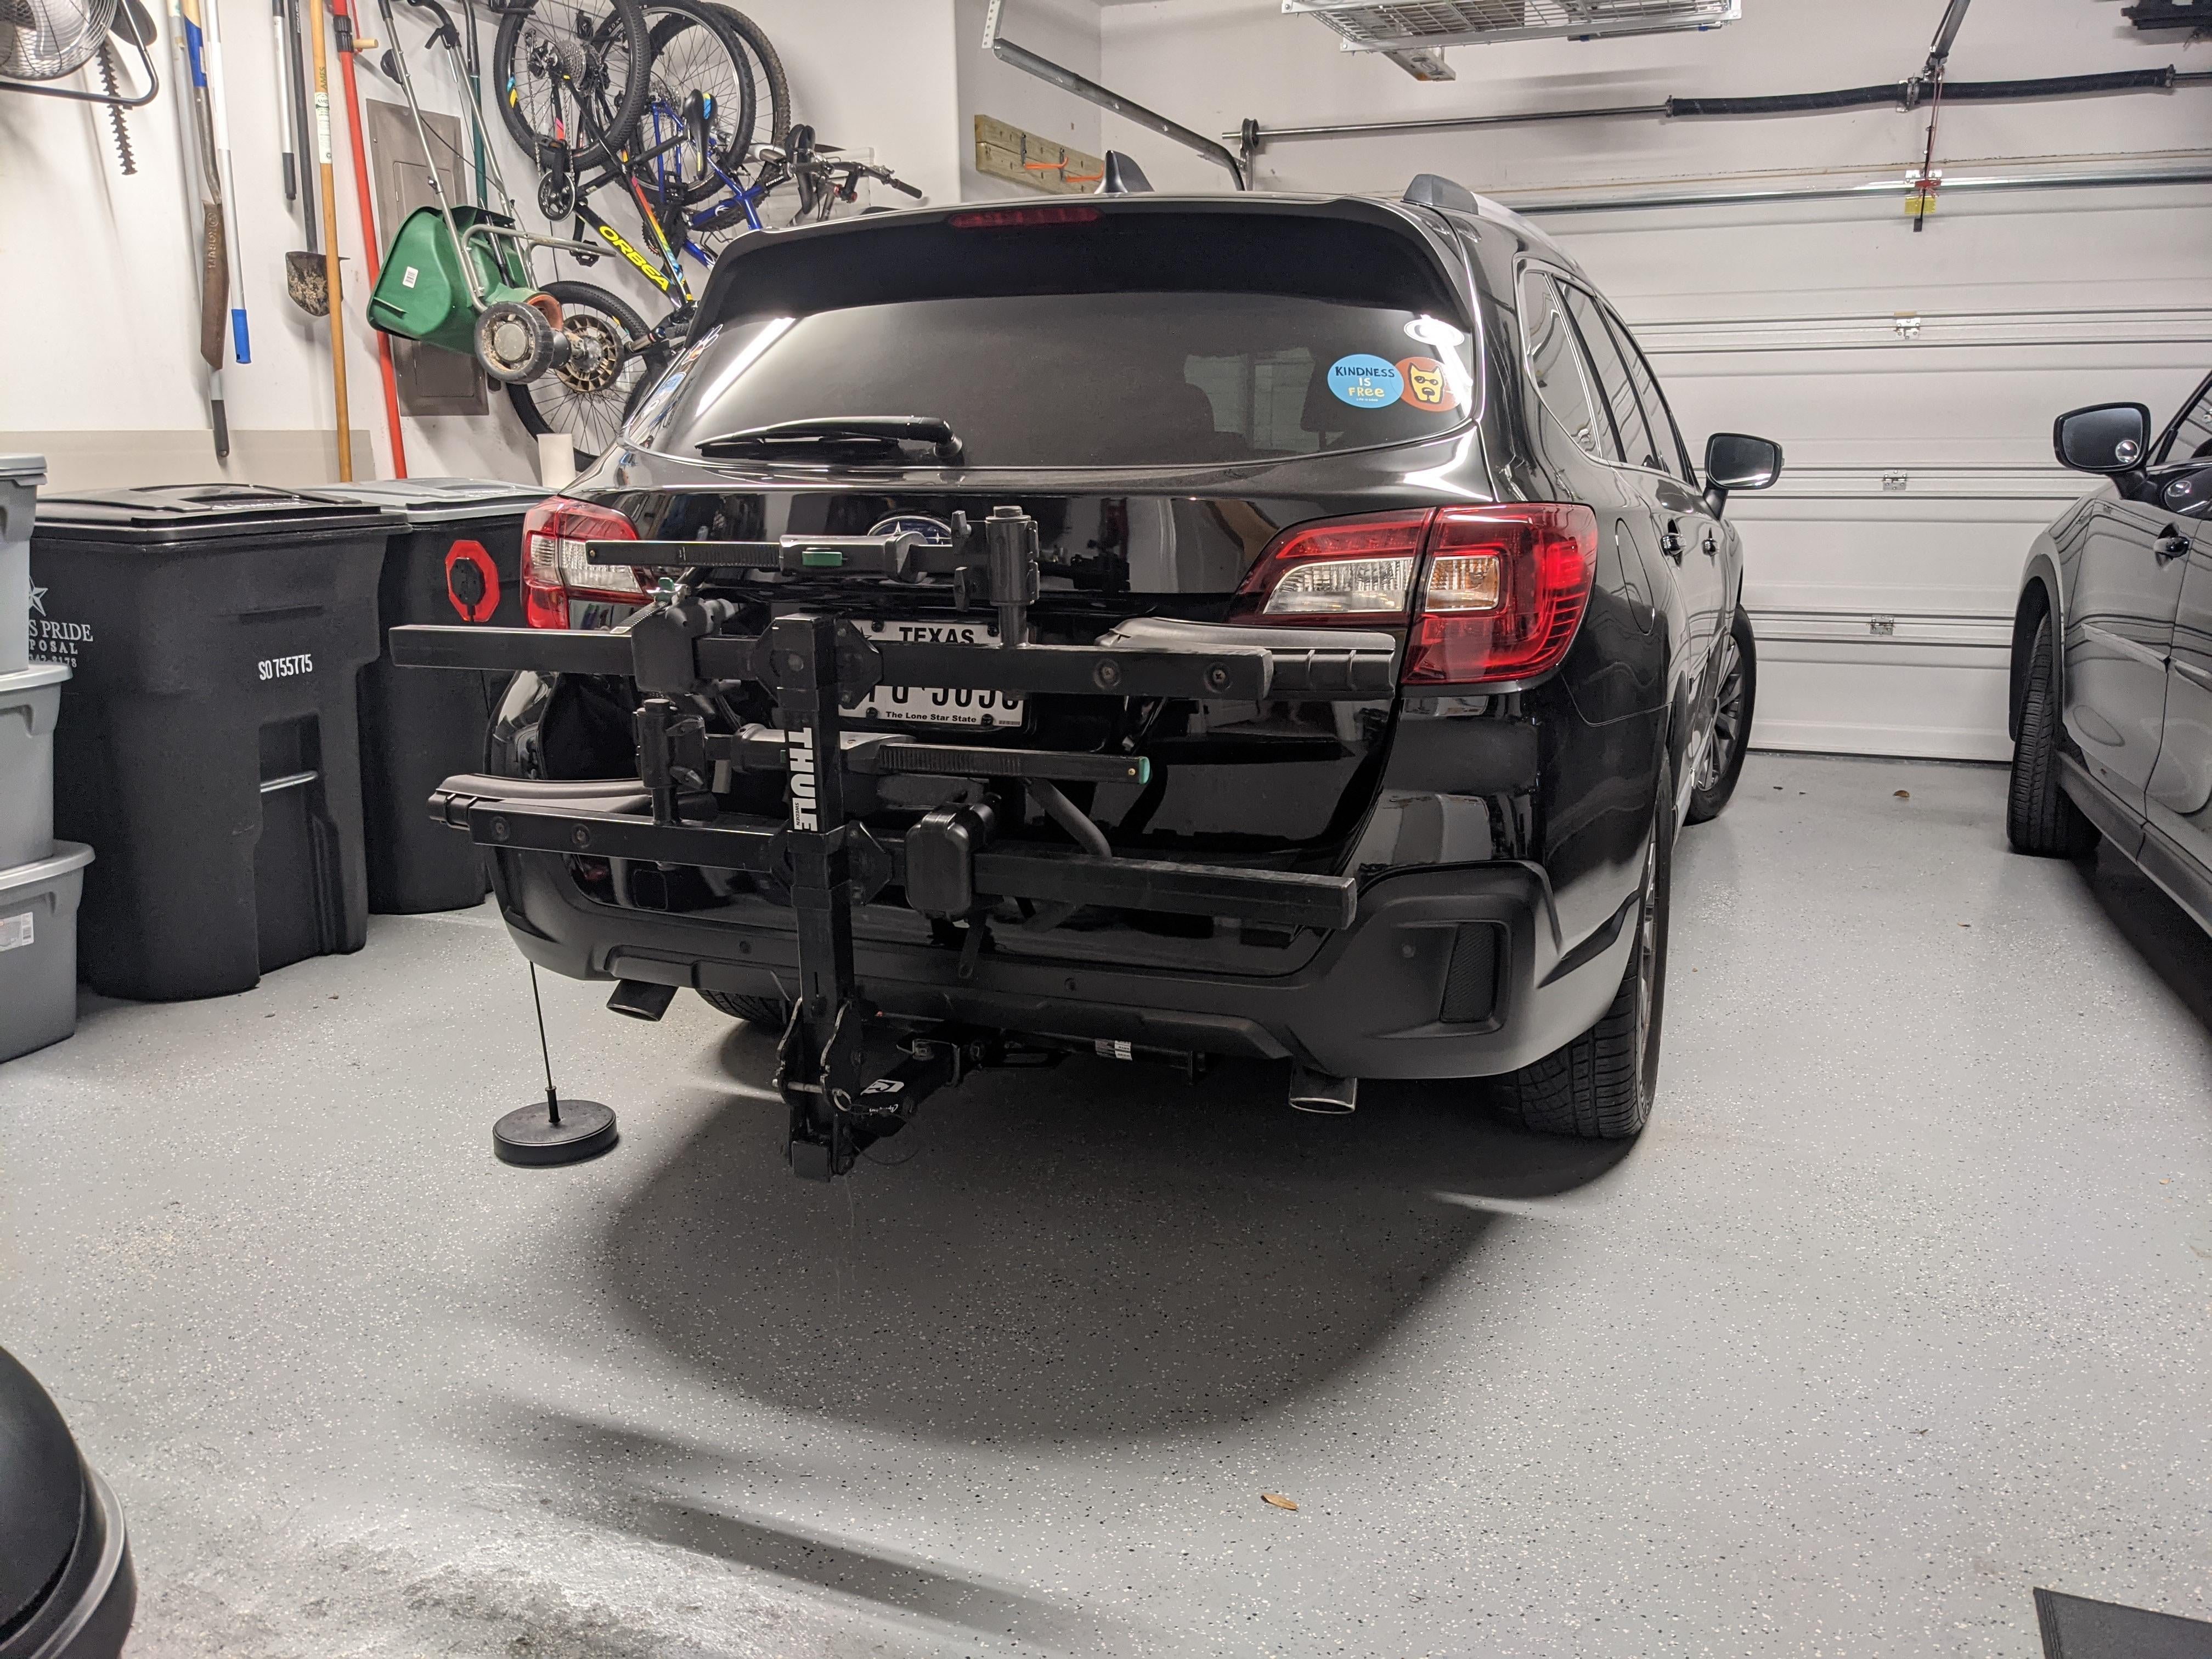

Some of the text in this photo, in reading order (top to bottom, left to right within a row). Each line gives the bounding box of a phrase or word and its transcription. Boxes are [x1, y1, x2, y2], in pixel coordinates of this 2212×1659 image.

[319, 67, 328, 90] AMES
[599, 226, 669, 291] ORBEA
[1335, 366, 1395, 377] KINDNESS
[1358, 377, 1372, 387] IS
[40, 620, 93, 642] PRIDE
[899, 627, 974, 644] TEXAS
[272, 653, 313, 678] 755775
[952, 715, 977, 723] State
[788, 727, 818, 832] THULE
